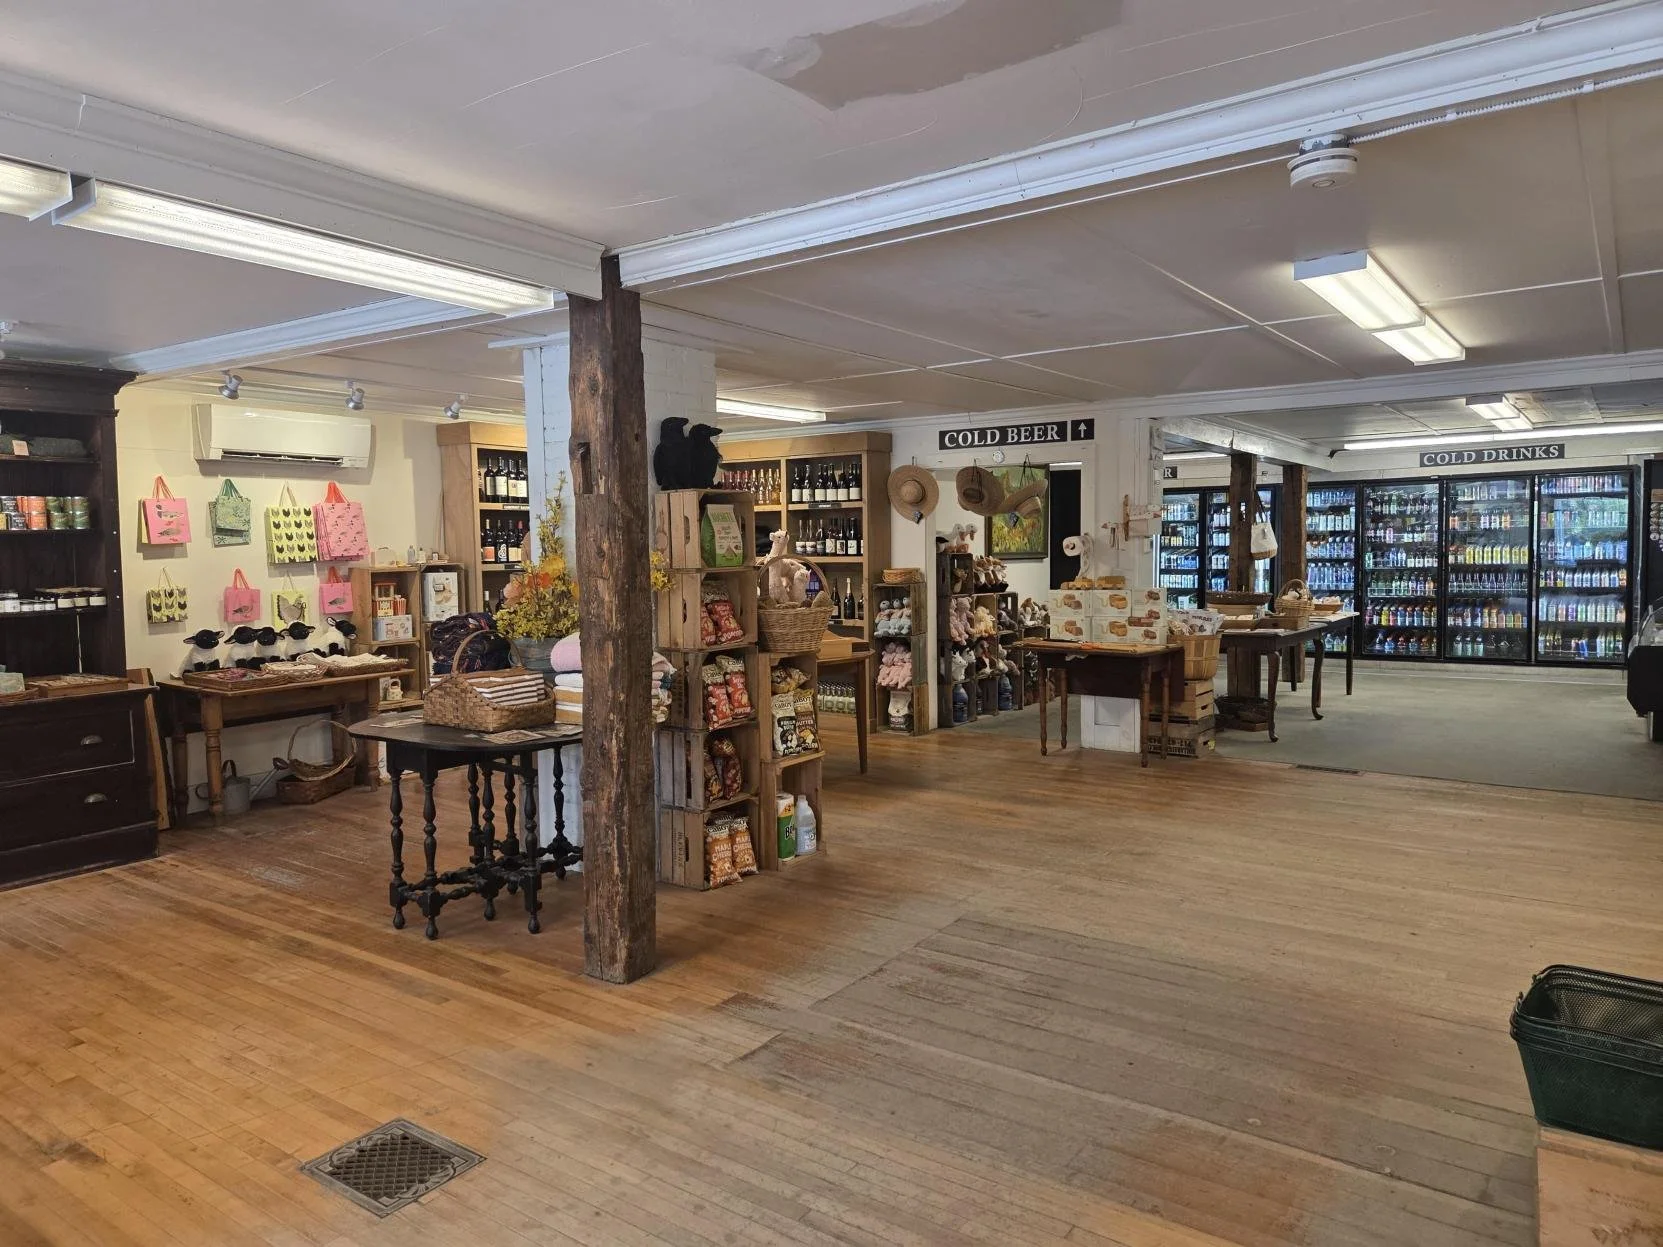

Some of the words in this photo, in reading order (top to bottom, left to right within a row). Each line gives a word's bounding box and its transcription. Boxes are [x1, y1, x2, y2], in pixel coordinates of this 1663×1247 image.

[944, 429, 1000, 448] COLD
[1006, 424, 1061, 443] BEER
[1423, 451, 1476, 465] COLD
[1483, 445, 1559, 462] DRINKS
